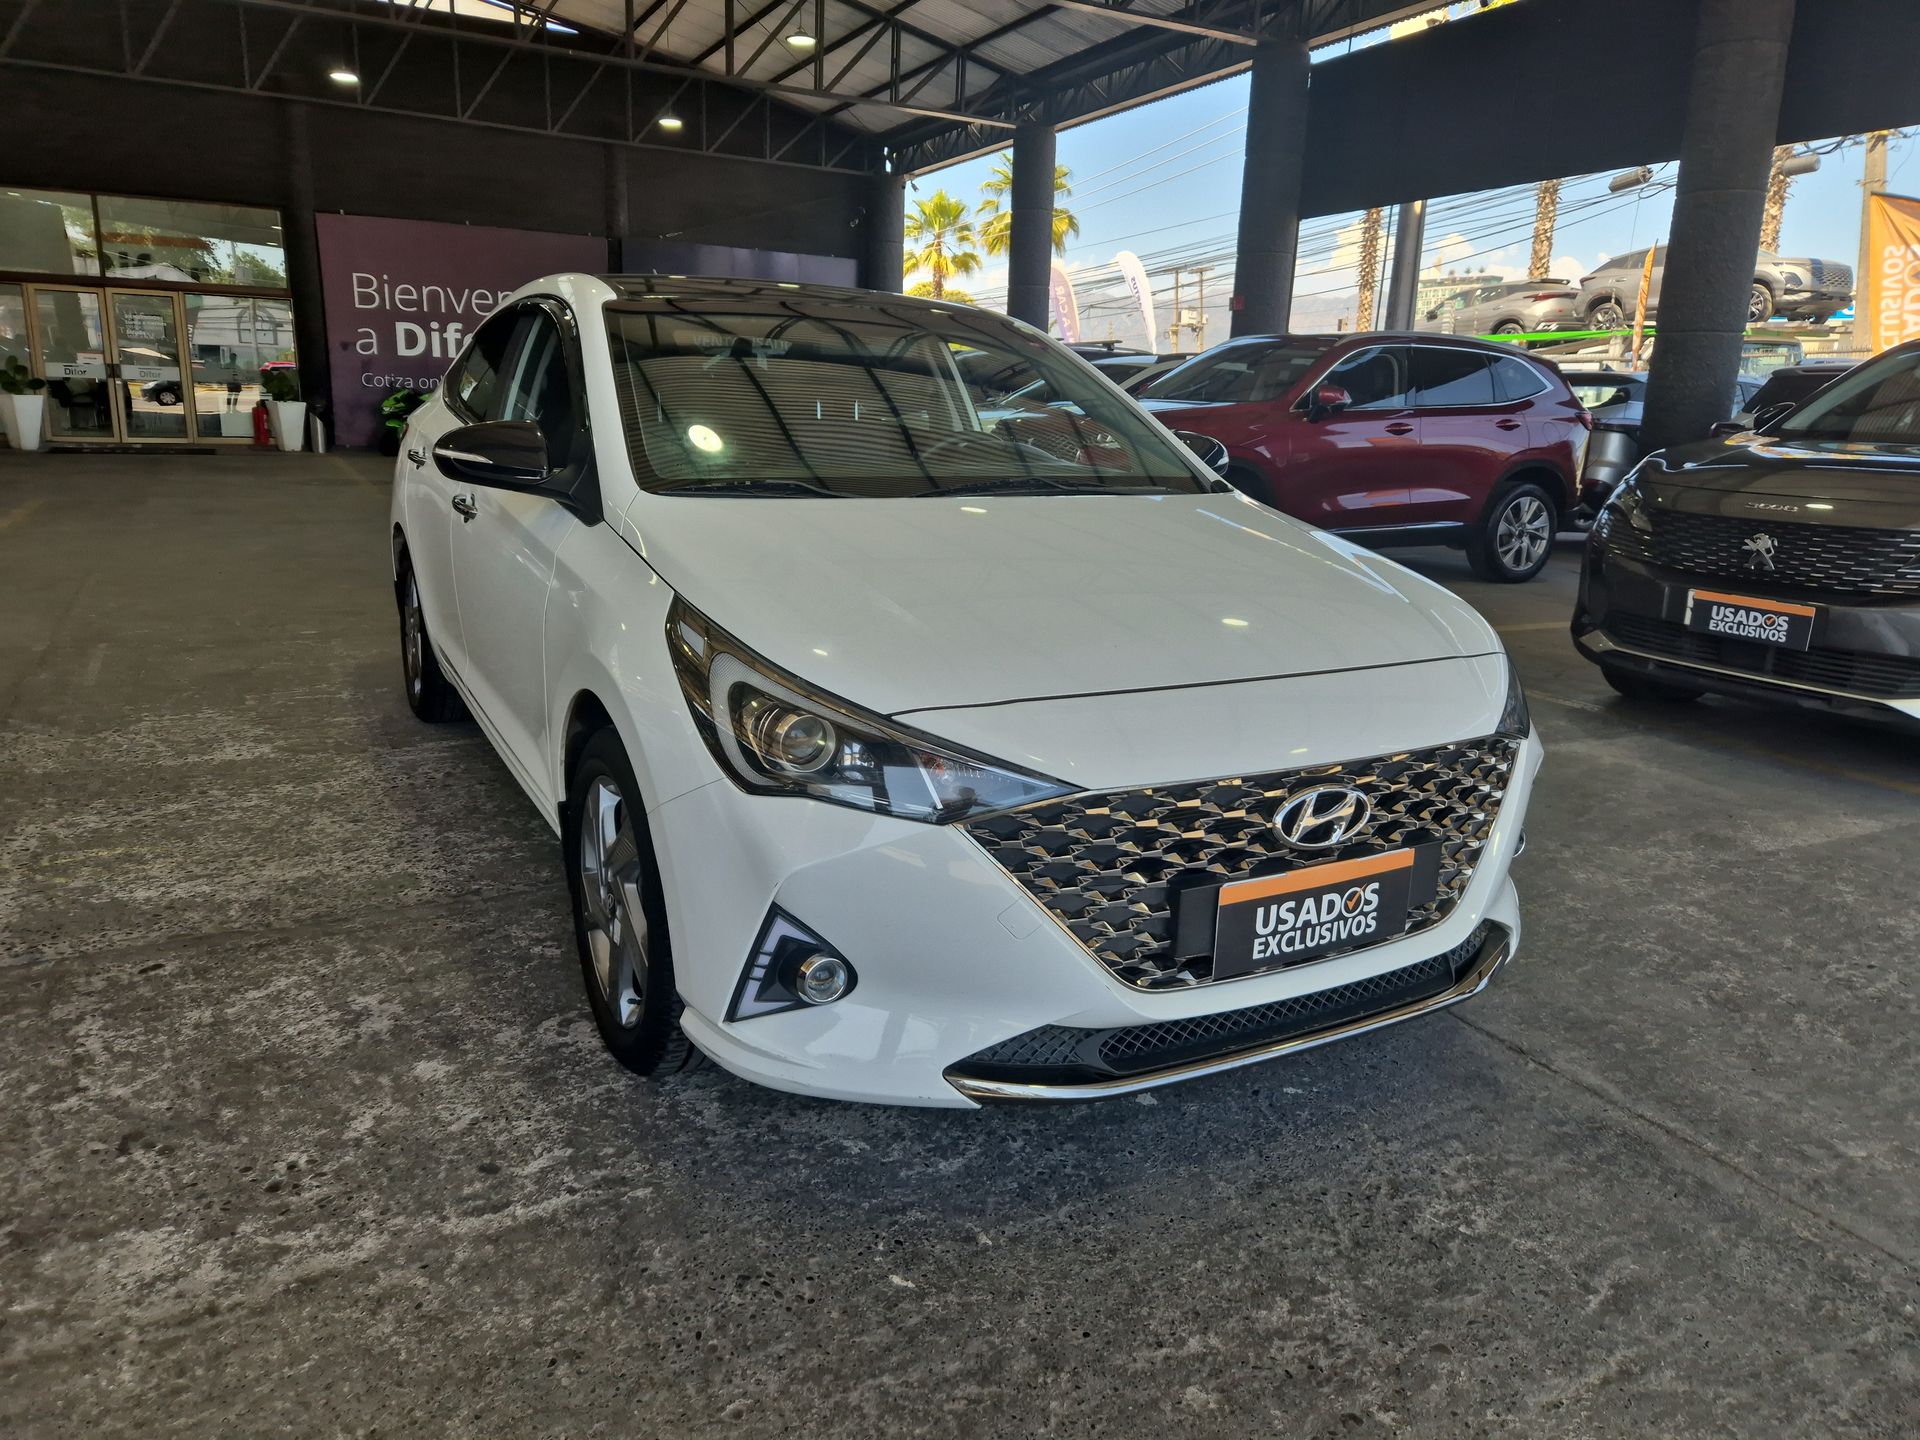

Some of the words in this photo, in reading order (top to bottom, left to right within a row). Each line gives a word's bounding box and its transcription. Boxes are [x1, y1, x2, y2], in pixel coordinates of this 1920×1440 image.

[355, 327, 378, 355] a
[395, 321, 473, 358] Dif
[361, 372, 414, 388] Cotiza
[1709, 620, 1787, 643] EXCLUSIVOS
[1711, 605, 1789, 631] USADOS
[1255, 882, 1380, 935] USADOS
[1252, 911, 1377, 960] EXCLUSIVOS
